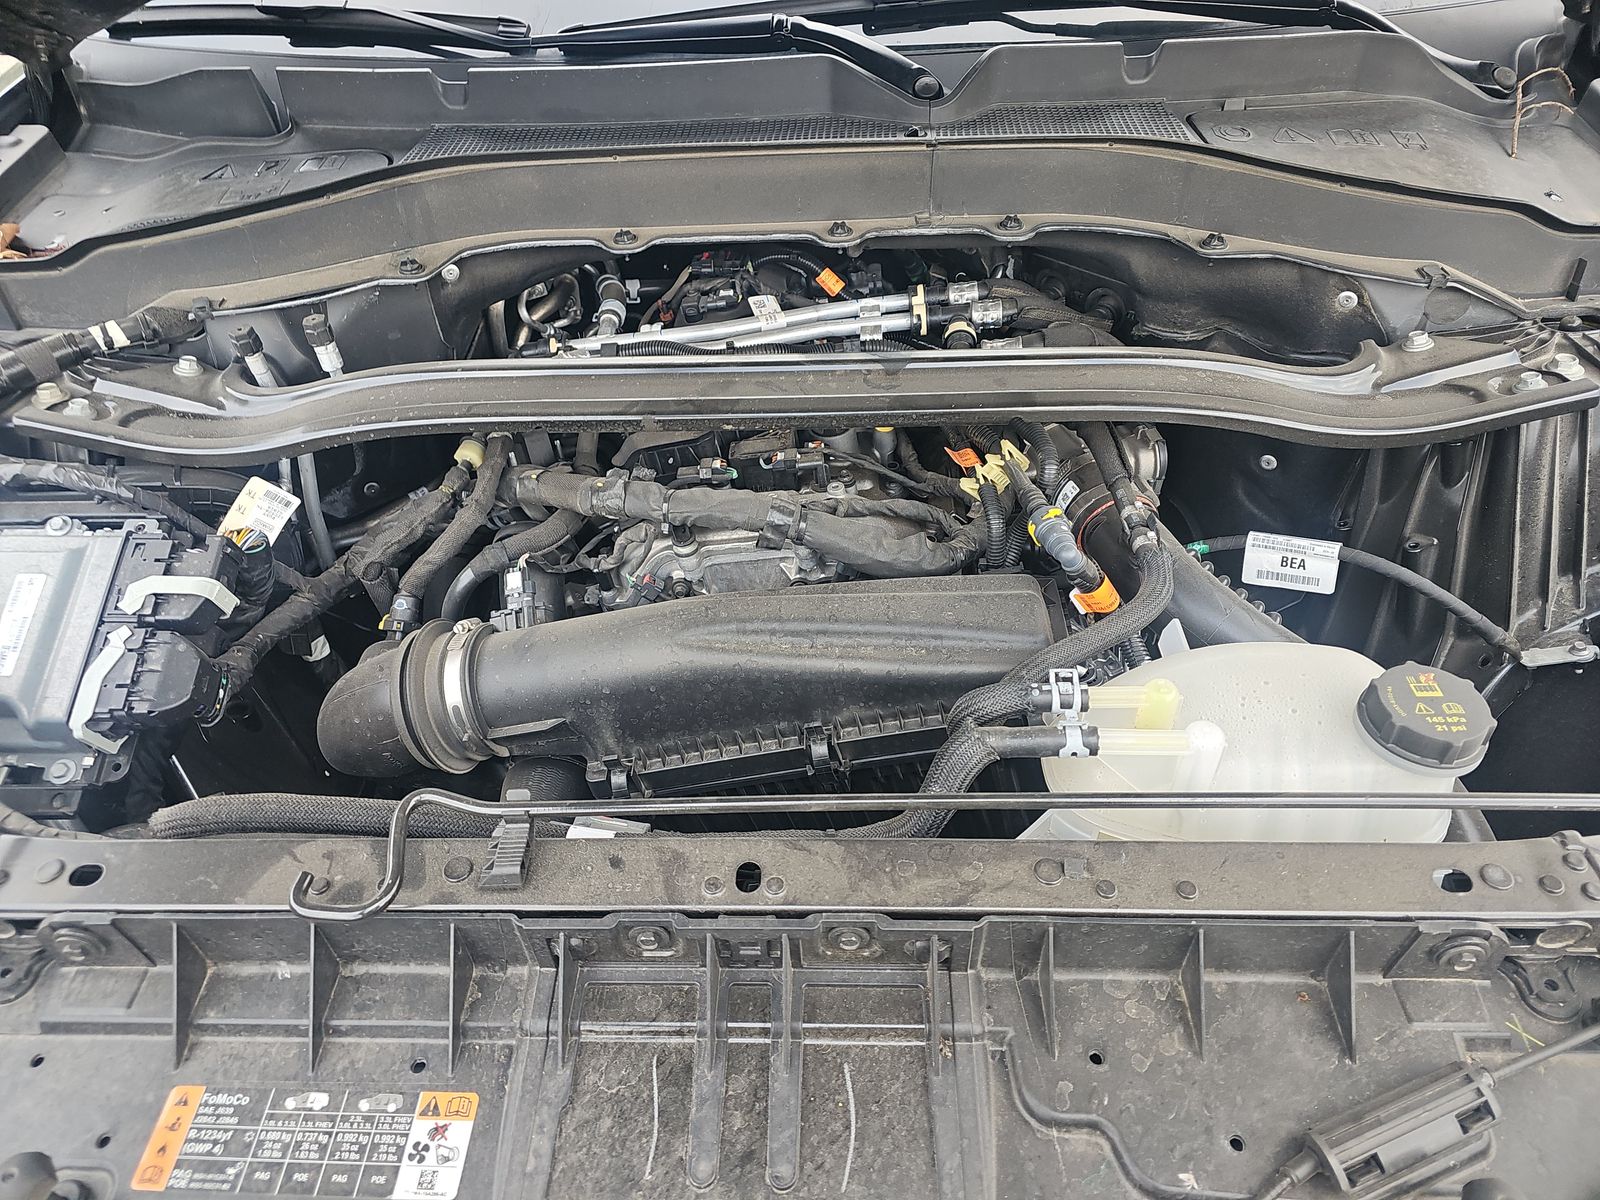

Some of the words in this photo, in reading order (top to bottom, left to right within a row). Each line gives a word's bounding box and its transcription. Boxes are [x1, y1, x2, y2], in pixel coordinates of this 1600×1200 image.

[1280, 555, 1306, 571] BEA
[1451, 724, 1467, 733] psi
[202, 1093, 250, 1105] FoMoCo
[197, 1106, 215, 1115] SAE
[281, 1131, 292, 1143] kg
[296, 1132, 318, 1141] 0.737
[318, 1132, 329, 1144] kg
[336, 1133, 358, 1142] 0.992
[358, 1133, 369, 1144] kg
[374, 1134, 396, 1143] 0.992
[395, 1135, 407, 1146] kg
[341, 1142, 351, 1151] 35
[379, 1144, 388, 1152] 35
[308, 1151, 320, 1159] lbs
[334, 1151, 349, 1160] 2.19
[349, 1152, 360, 1160] lbs
[372, 1153, 387, 1161] 2.19
[387, 1153, 398, 1161] lbs
[171, 1168, 193, 1178] PAG
[254, 1171, 271, 1180] PAG
[293, 1172, 309, 1181] POE
[331, 1174, 348, 1183] PAG
[370, 1175, 387, 1184] POE
